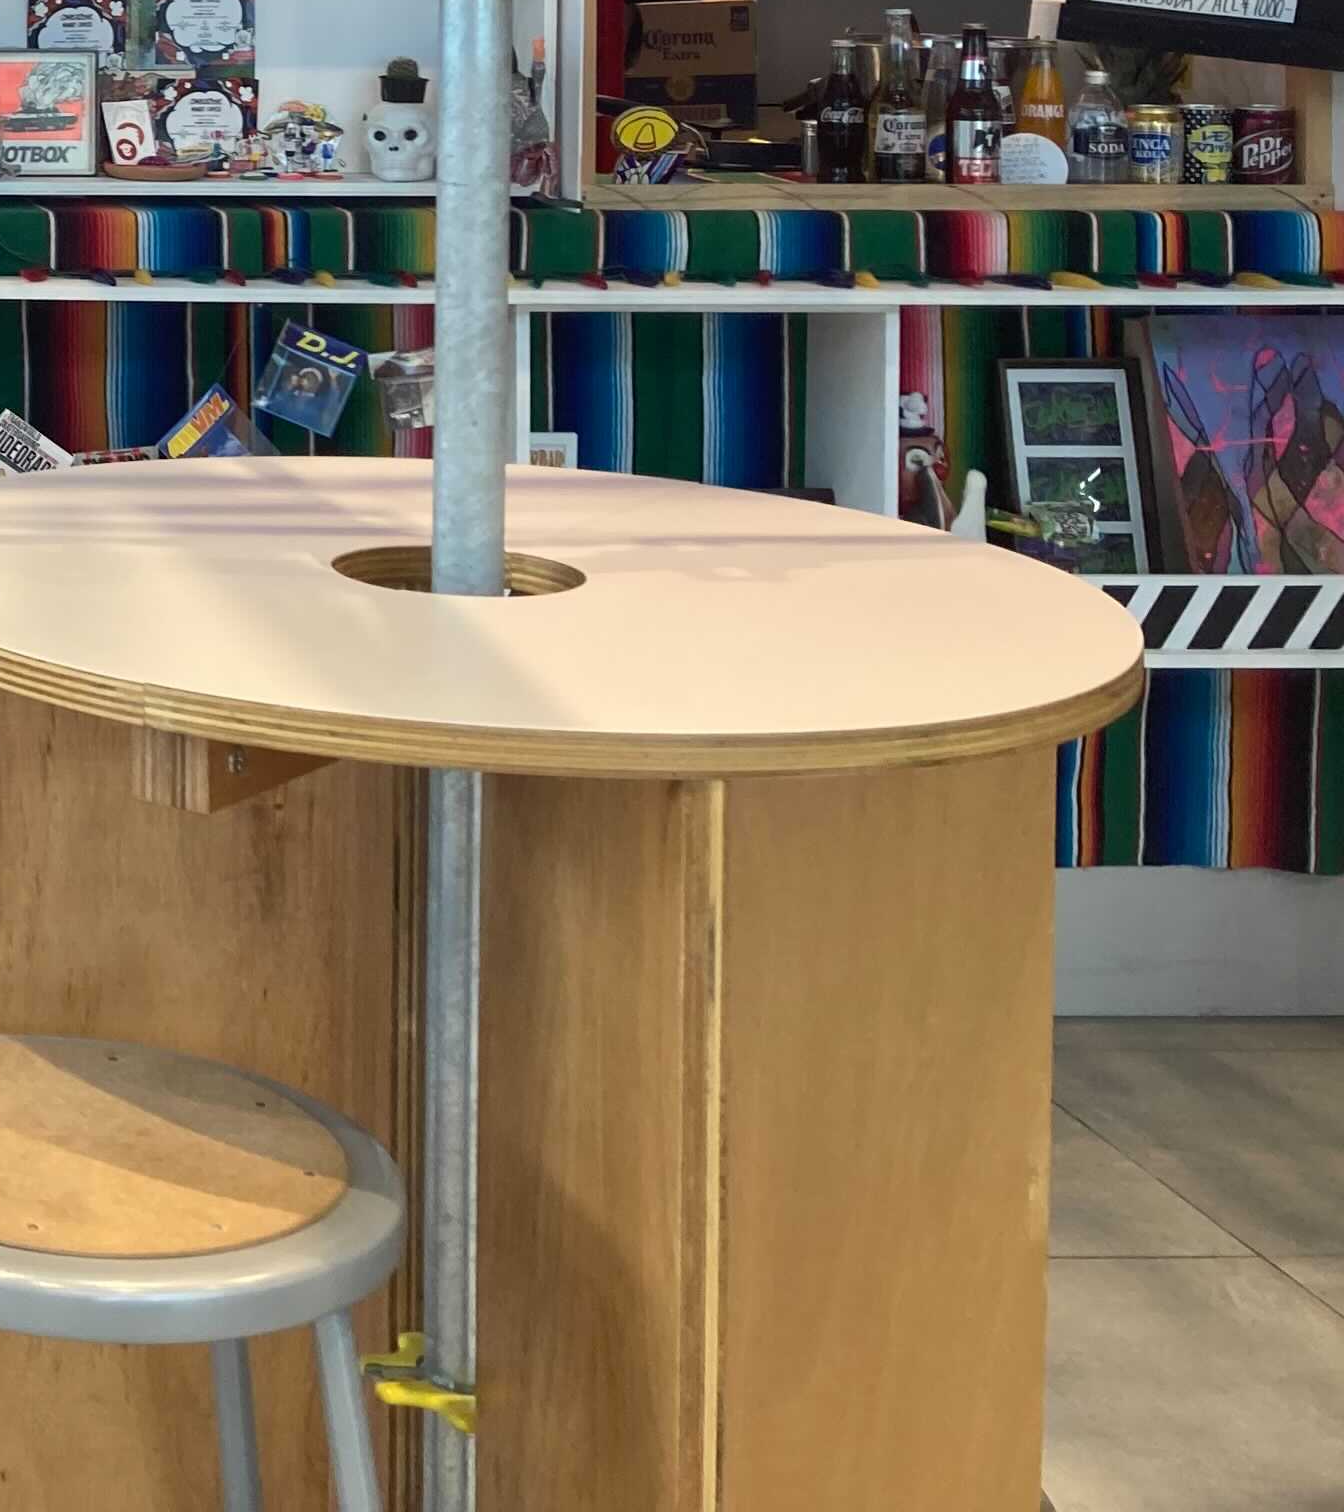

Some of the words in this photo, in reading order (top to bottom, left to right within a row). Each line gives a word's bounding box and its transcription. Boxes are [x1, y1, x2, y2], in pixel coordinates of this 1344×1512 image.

[642, 29, 717, 53] Corona
[1088, 142, 1126, 154] SODA
[1259, 137, 1284, 153] Dr
[1242, 142, 1293, 169] Pepper
